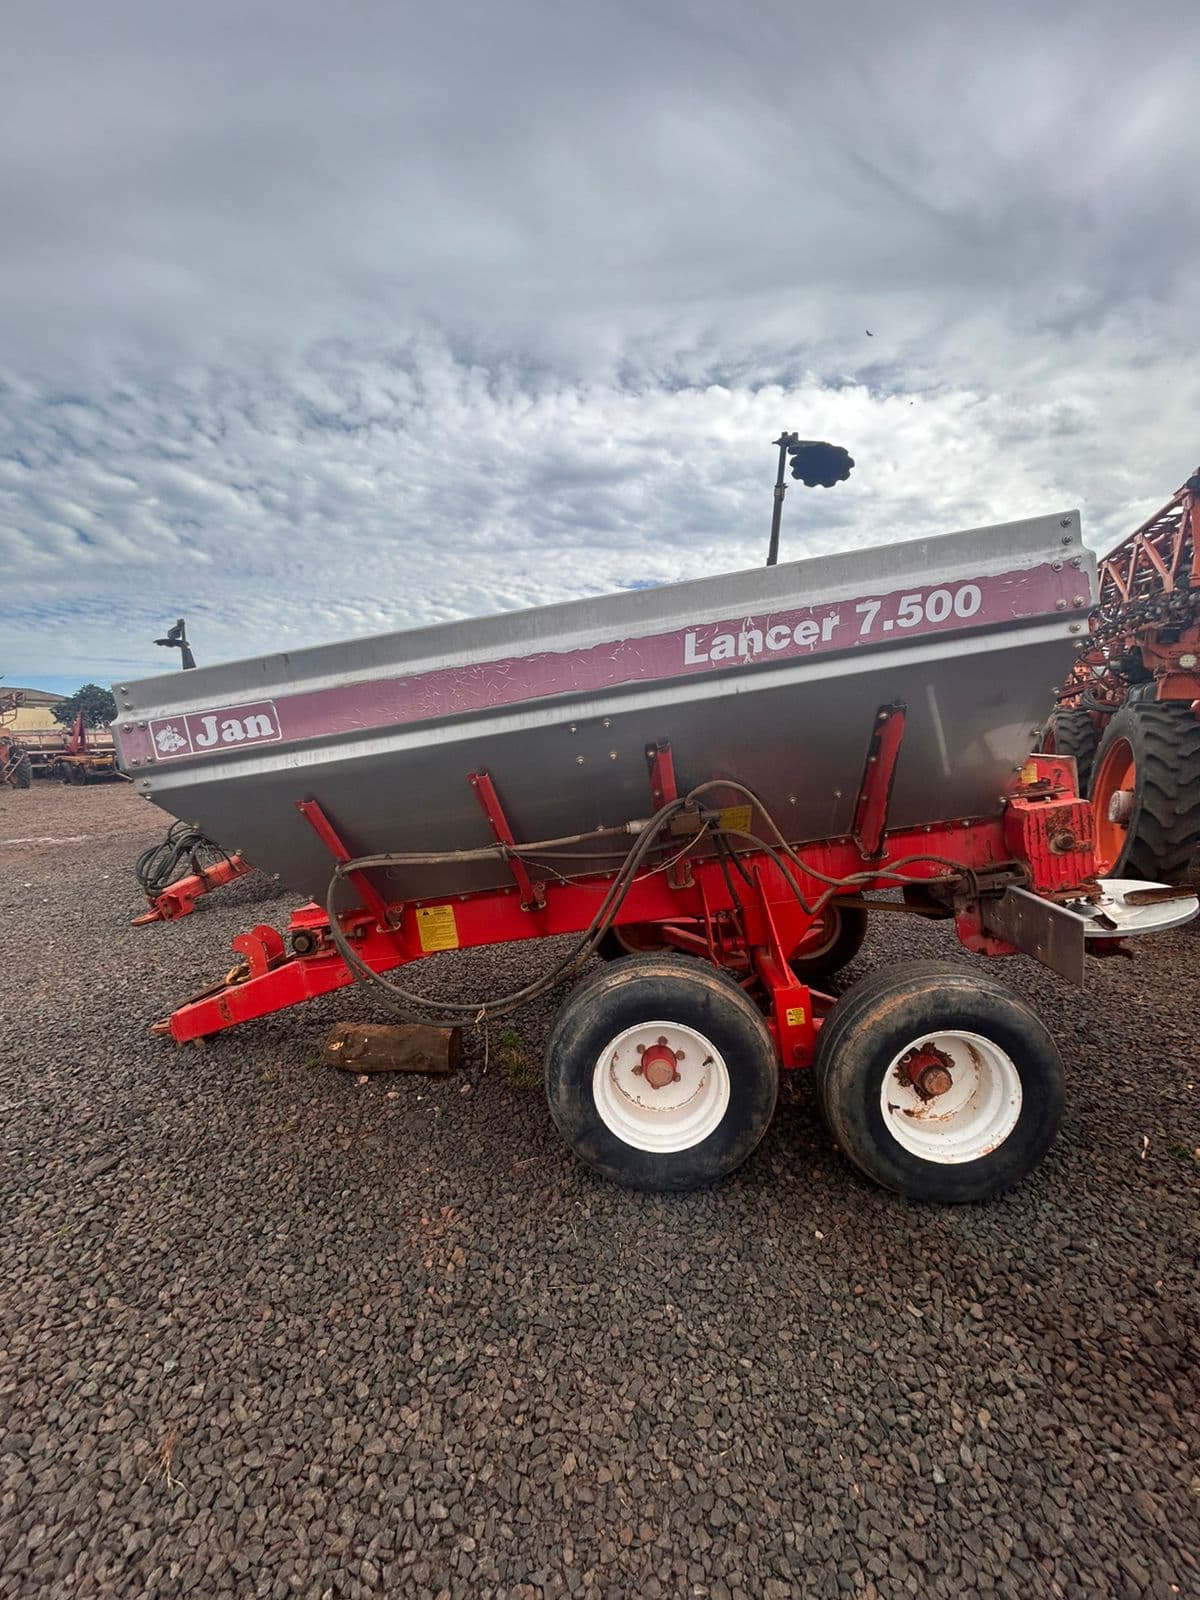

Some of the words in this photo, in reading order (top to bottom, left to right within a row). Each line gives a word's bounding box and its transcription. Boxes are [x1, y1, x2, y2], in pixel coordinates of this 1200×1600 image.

[684, 613, 840, 665] Lancer
[855, 584, 982, 636] 7.500
[196, 715, 275, 747] Jan
